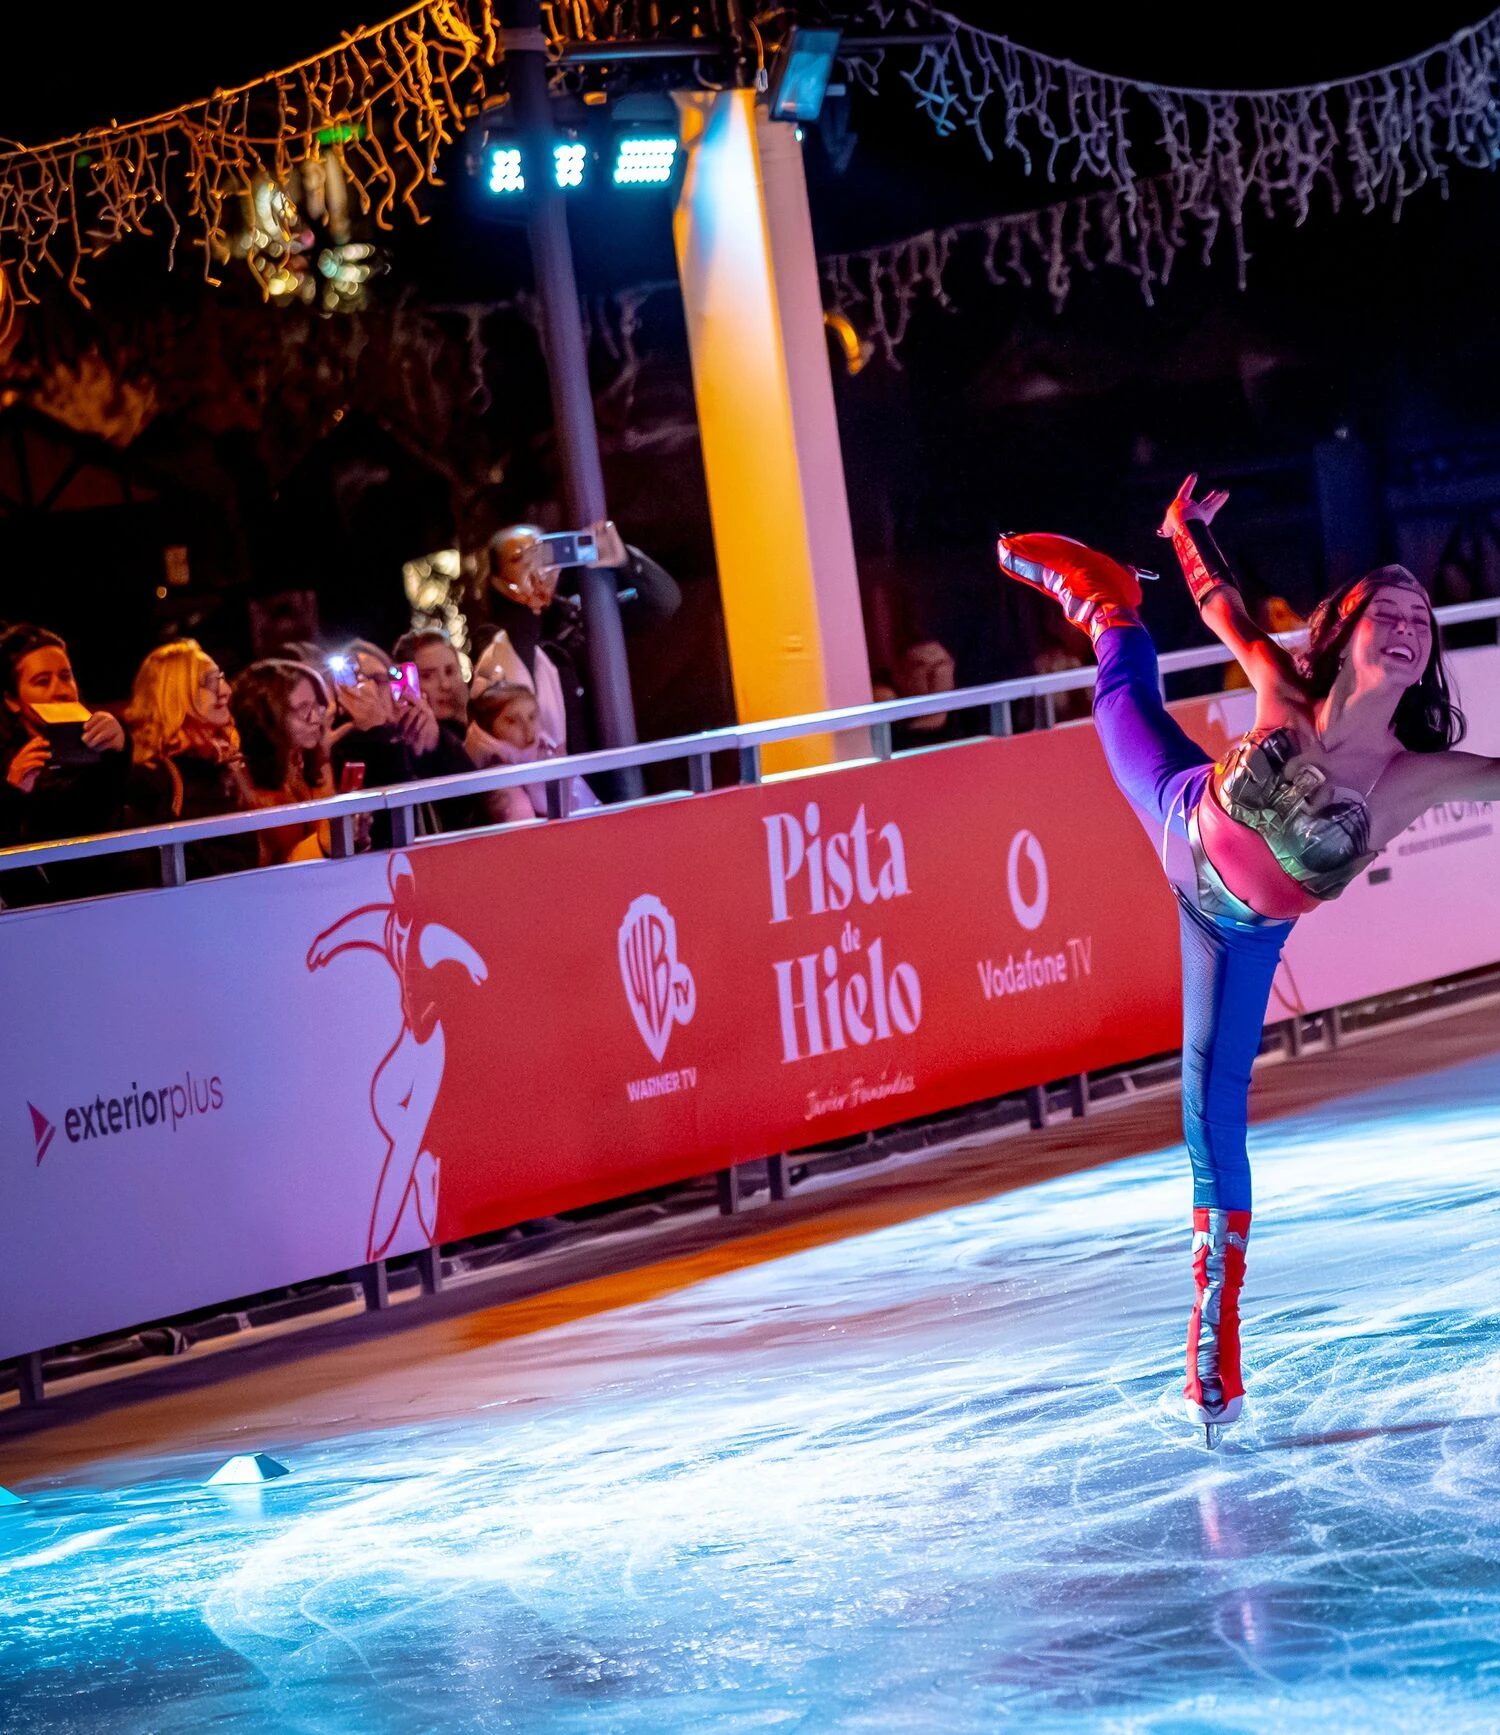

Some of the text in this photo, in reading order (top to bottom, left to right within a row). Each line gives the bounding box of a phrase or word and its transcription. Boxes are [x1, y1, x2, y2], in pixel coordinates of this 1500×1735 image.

[762, 801, 912, 924] Pista
[841, 921, 862, 954] de
[976, 935, 1092, 1001] Vodafone TV
[772, 937, 922, 1064] Hielo
[64, 1071, 225, 1144] exteriorplus
[626, 1066, 698, 1102] WARNER TV
